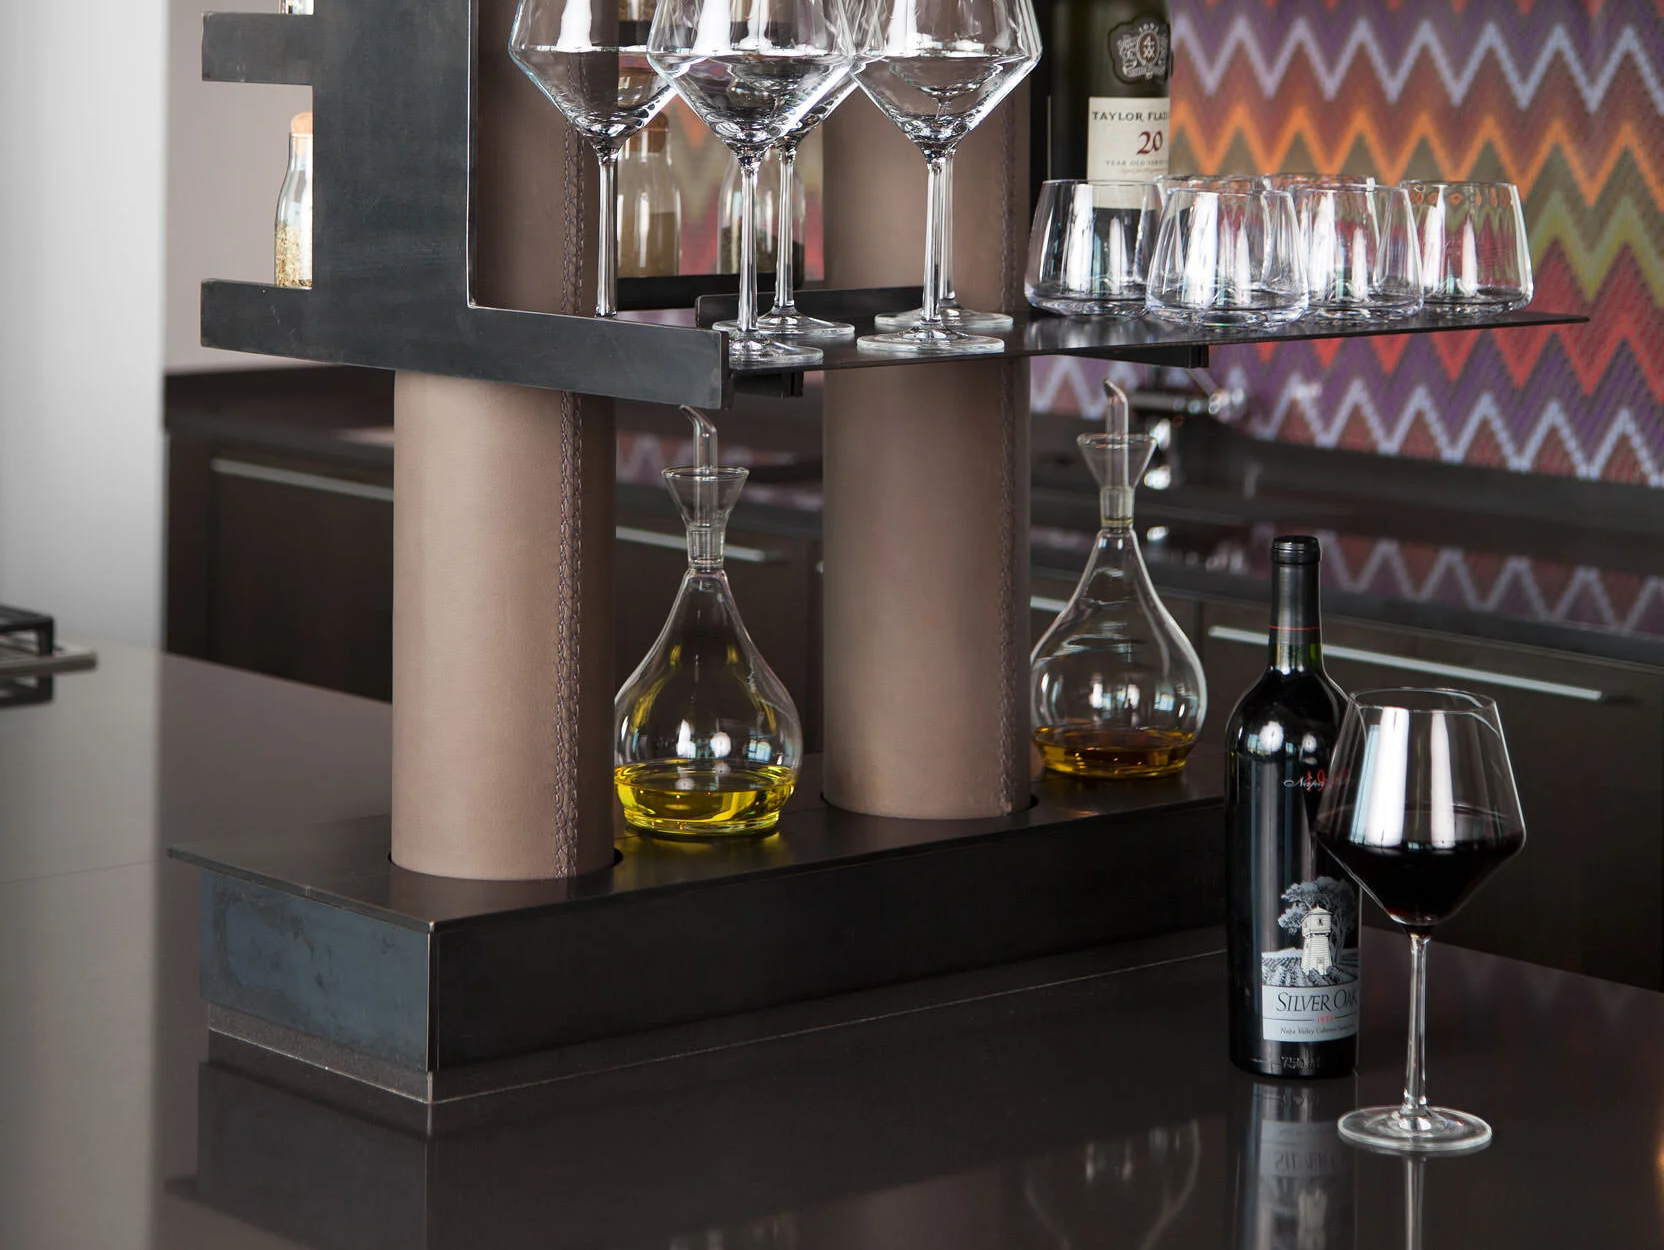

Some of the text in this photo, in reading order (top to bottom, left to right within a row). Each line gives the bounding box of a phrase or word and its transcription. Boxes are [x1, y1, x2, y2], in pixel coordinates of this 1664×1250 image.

[1092, 110, 1143, 122] TAYLOR
[1136, 130, 1163, 155] 20
[1276, 991, 1333, 1012] SILVER
